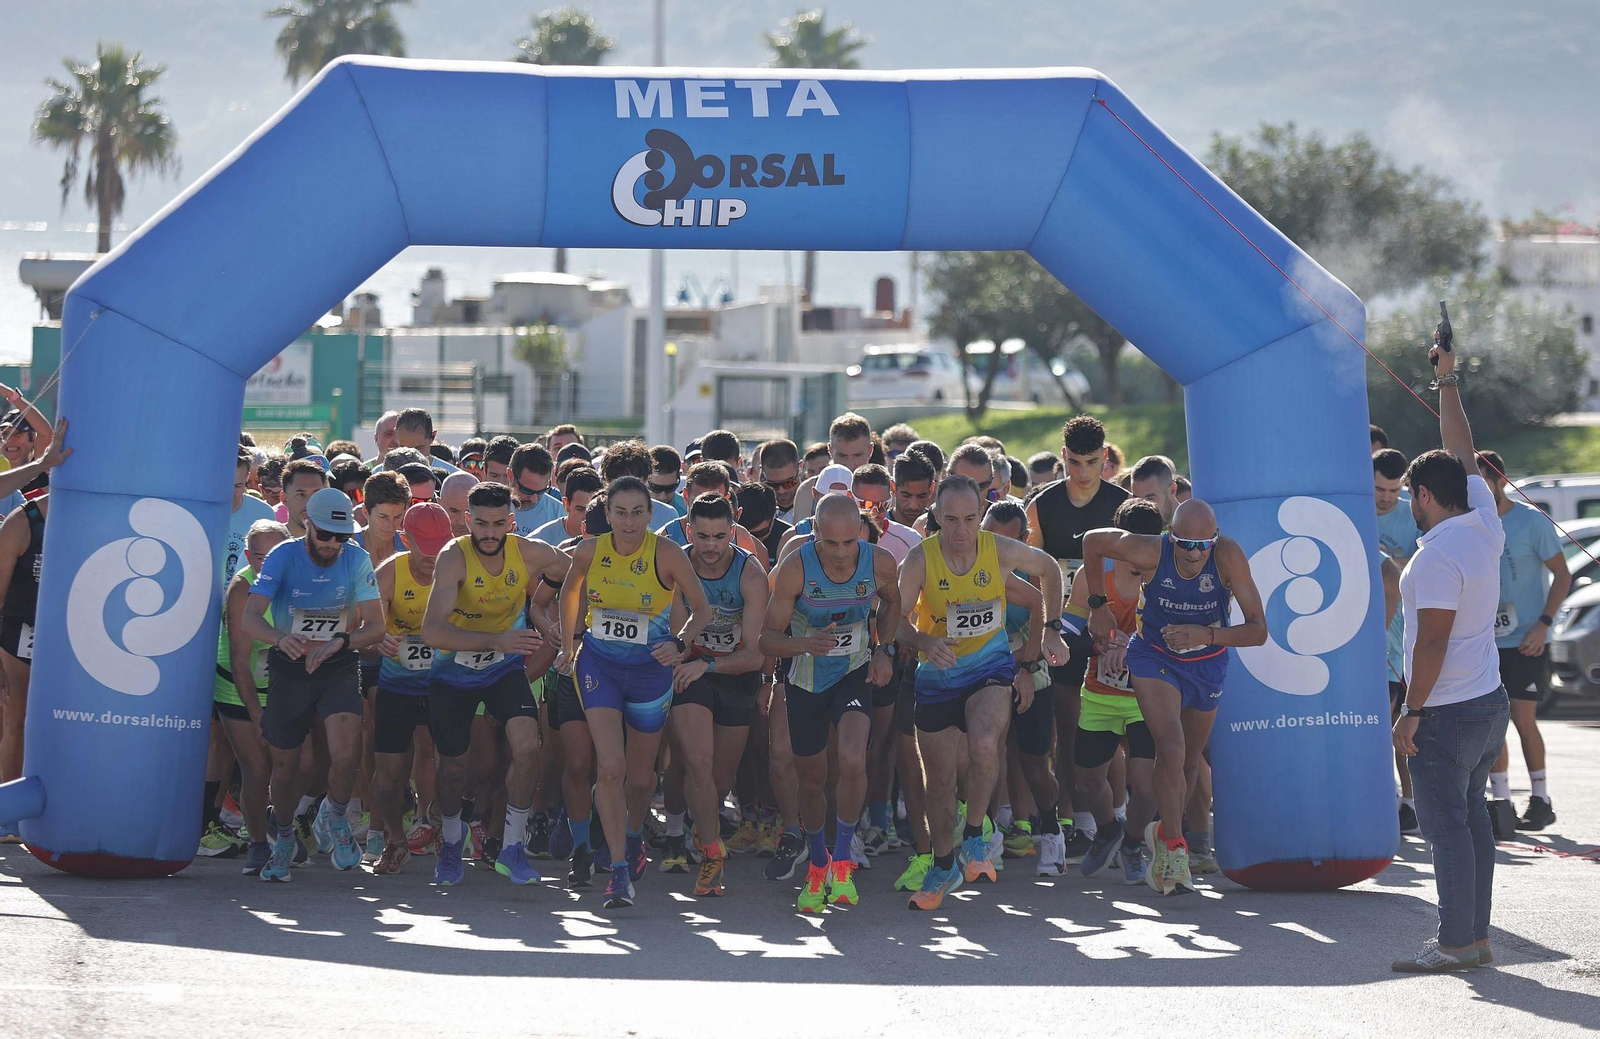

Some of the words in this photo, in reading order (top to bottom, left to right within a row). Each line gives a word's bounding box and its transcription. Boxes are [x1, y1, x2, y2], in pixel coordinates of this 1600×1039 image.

[614, 80, 840, 118] META
[644, 128, 846, 211] DORSAL
[611, 149, 748, 227] CHIP
[1158, 597, 1218, 611] Tirabuzón
[301, 619, 340, 632] 277
[601, 620, 638, 639] 180
[956, 611, 994, 628] 208
[700, 633, 735, 645] 113
[53, 708, 202, 731] www.dorsalchip.es
[1230, 711, 1379, 733] www.dorsalchip.es
